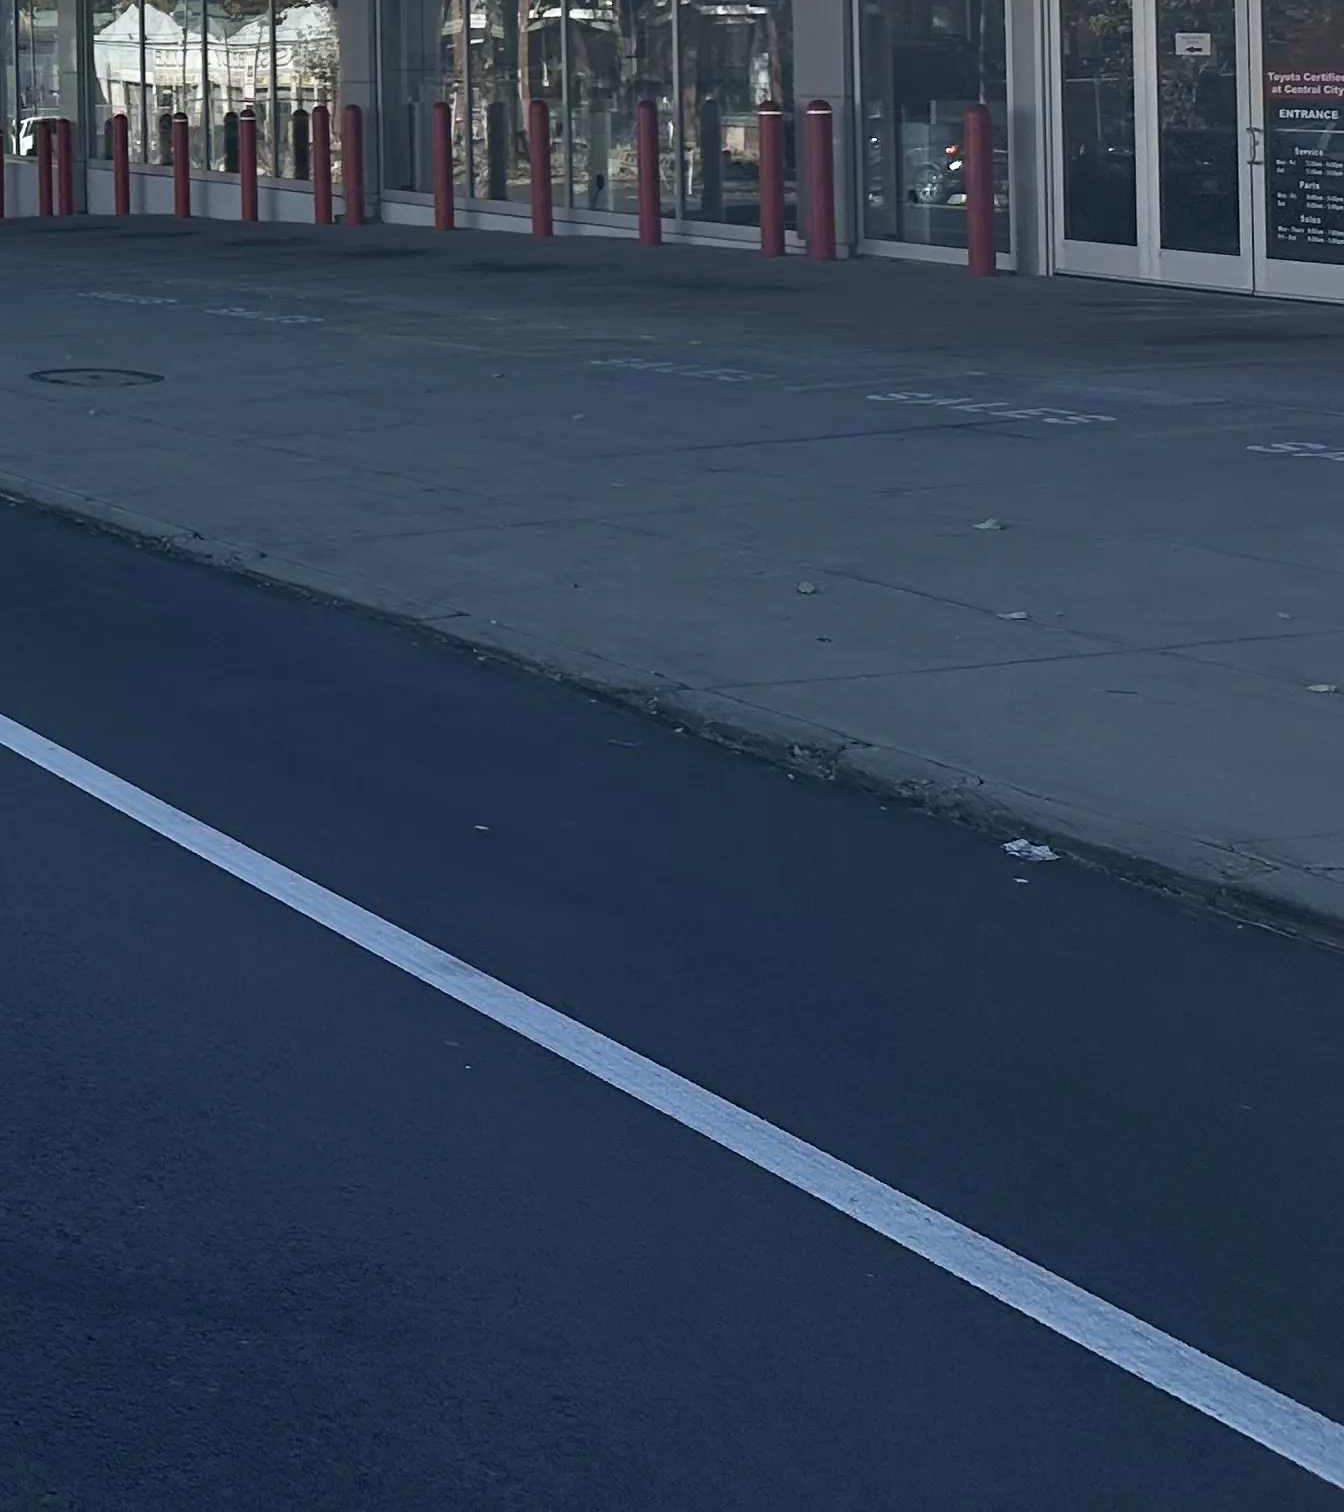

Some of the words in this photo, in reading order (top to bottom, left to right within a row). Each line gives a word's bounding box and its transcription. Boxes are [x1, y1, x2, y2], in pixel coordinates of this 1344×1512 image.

[1267, 72, 1301, 83] Toyota
[1271, 85, 1283, 94] at
[1284, 84, 1322, 94] Central
[1323, 85, 1344, 96] City
[1278, 108, 1340, 120] ENTRANCE
[866, 391, 1117, 425] SALES
